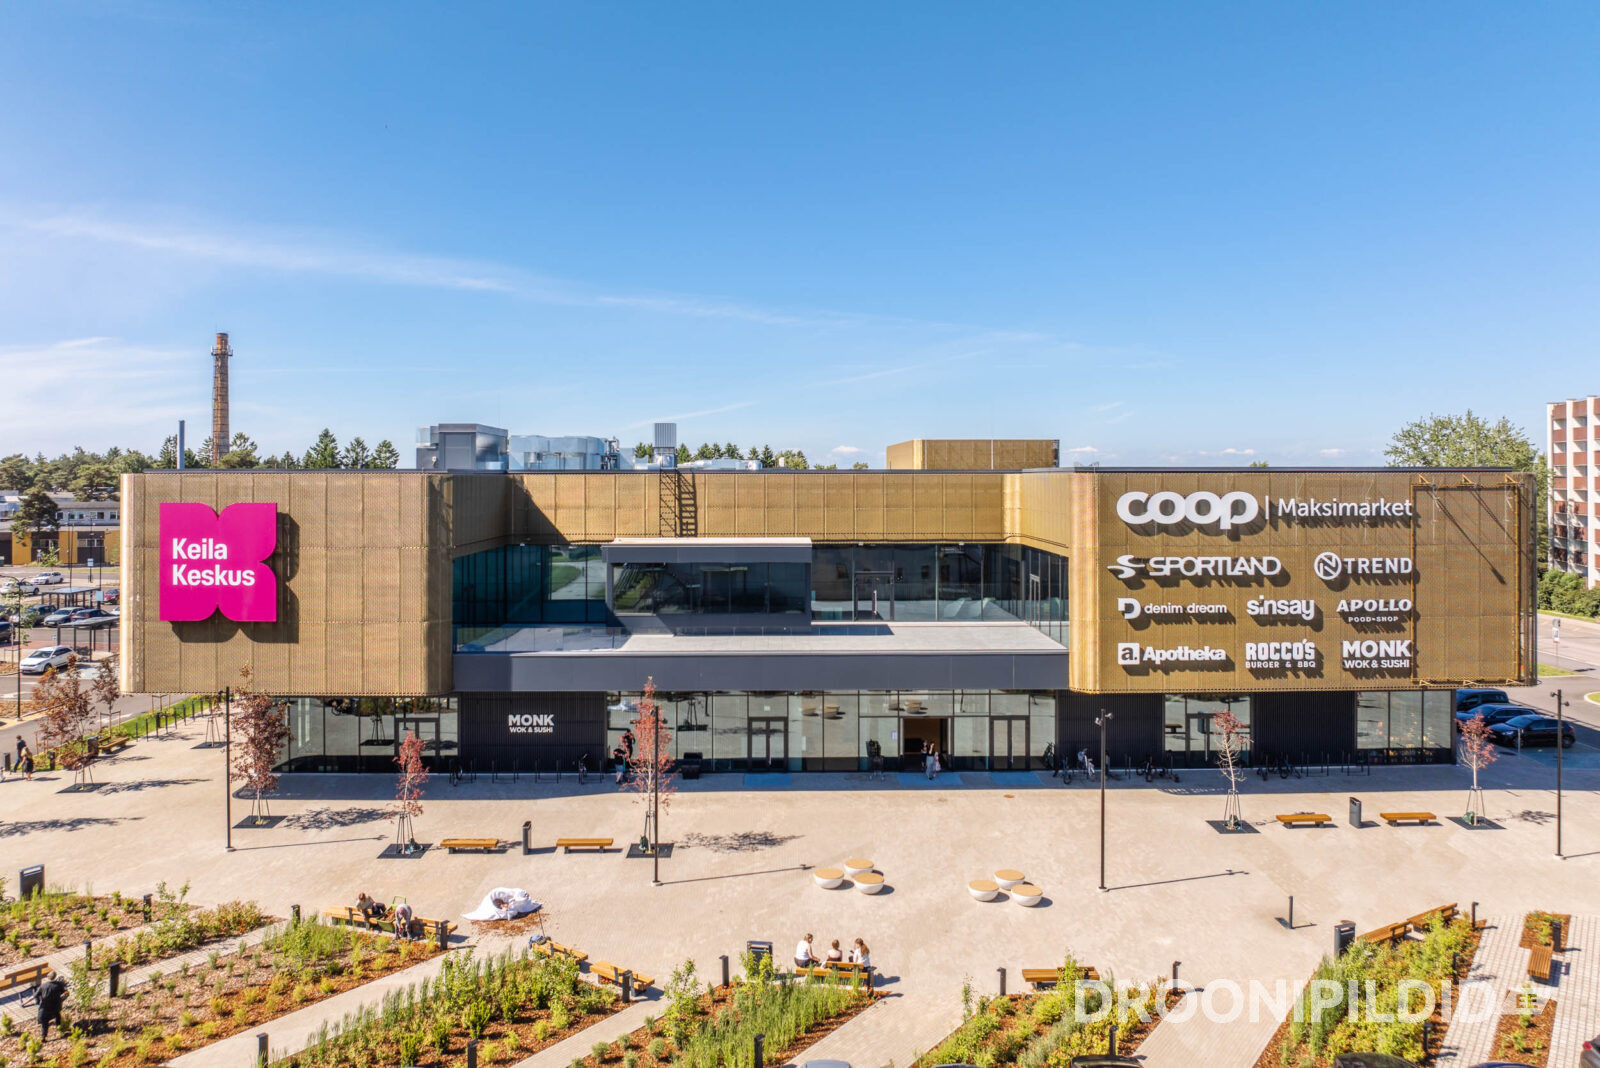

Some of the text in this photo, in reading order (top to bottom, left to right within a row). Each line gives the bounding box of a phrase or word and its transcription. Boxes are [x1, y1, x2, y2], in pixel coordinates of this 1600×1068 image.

[1116, 491, 1259, 530] coop
[1278, 498, 1413, 517] Maksimarket
[172, 538, 228, 560] Keila
[172, 564, 255, 586] Keskus
[1149, 556, 1281, 576] SPORTLAND
[1343, 557, 1413, 574] TREND
[1144, 602, 1183, 614] denim
[1186, 602, 1228, 614] dream
[1246, 594, 1315, 621] sinsay
[1336, 599, 1412, 612] APOLLO
[1142, 645, 1227, 665] Apotheka
[1245, 638, 1316, 661] ROCCO'S
[1342, 640, 1412, 658] MONK
[1245, 661, 1280, 669] BURGER
[1297, 661, 1316, 669] BBQ
[1344, 660, 1410, 669] WOK & SUSHI
[508, 714, 555, 726] MONK
